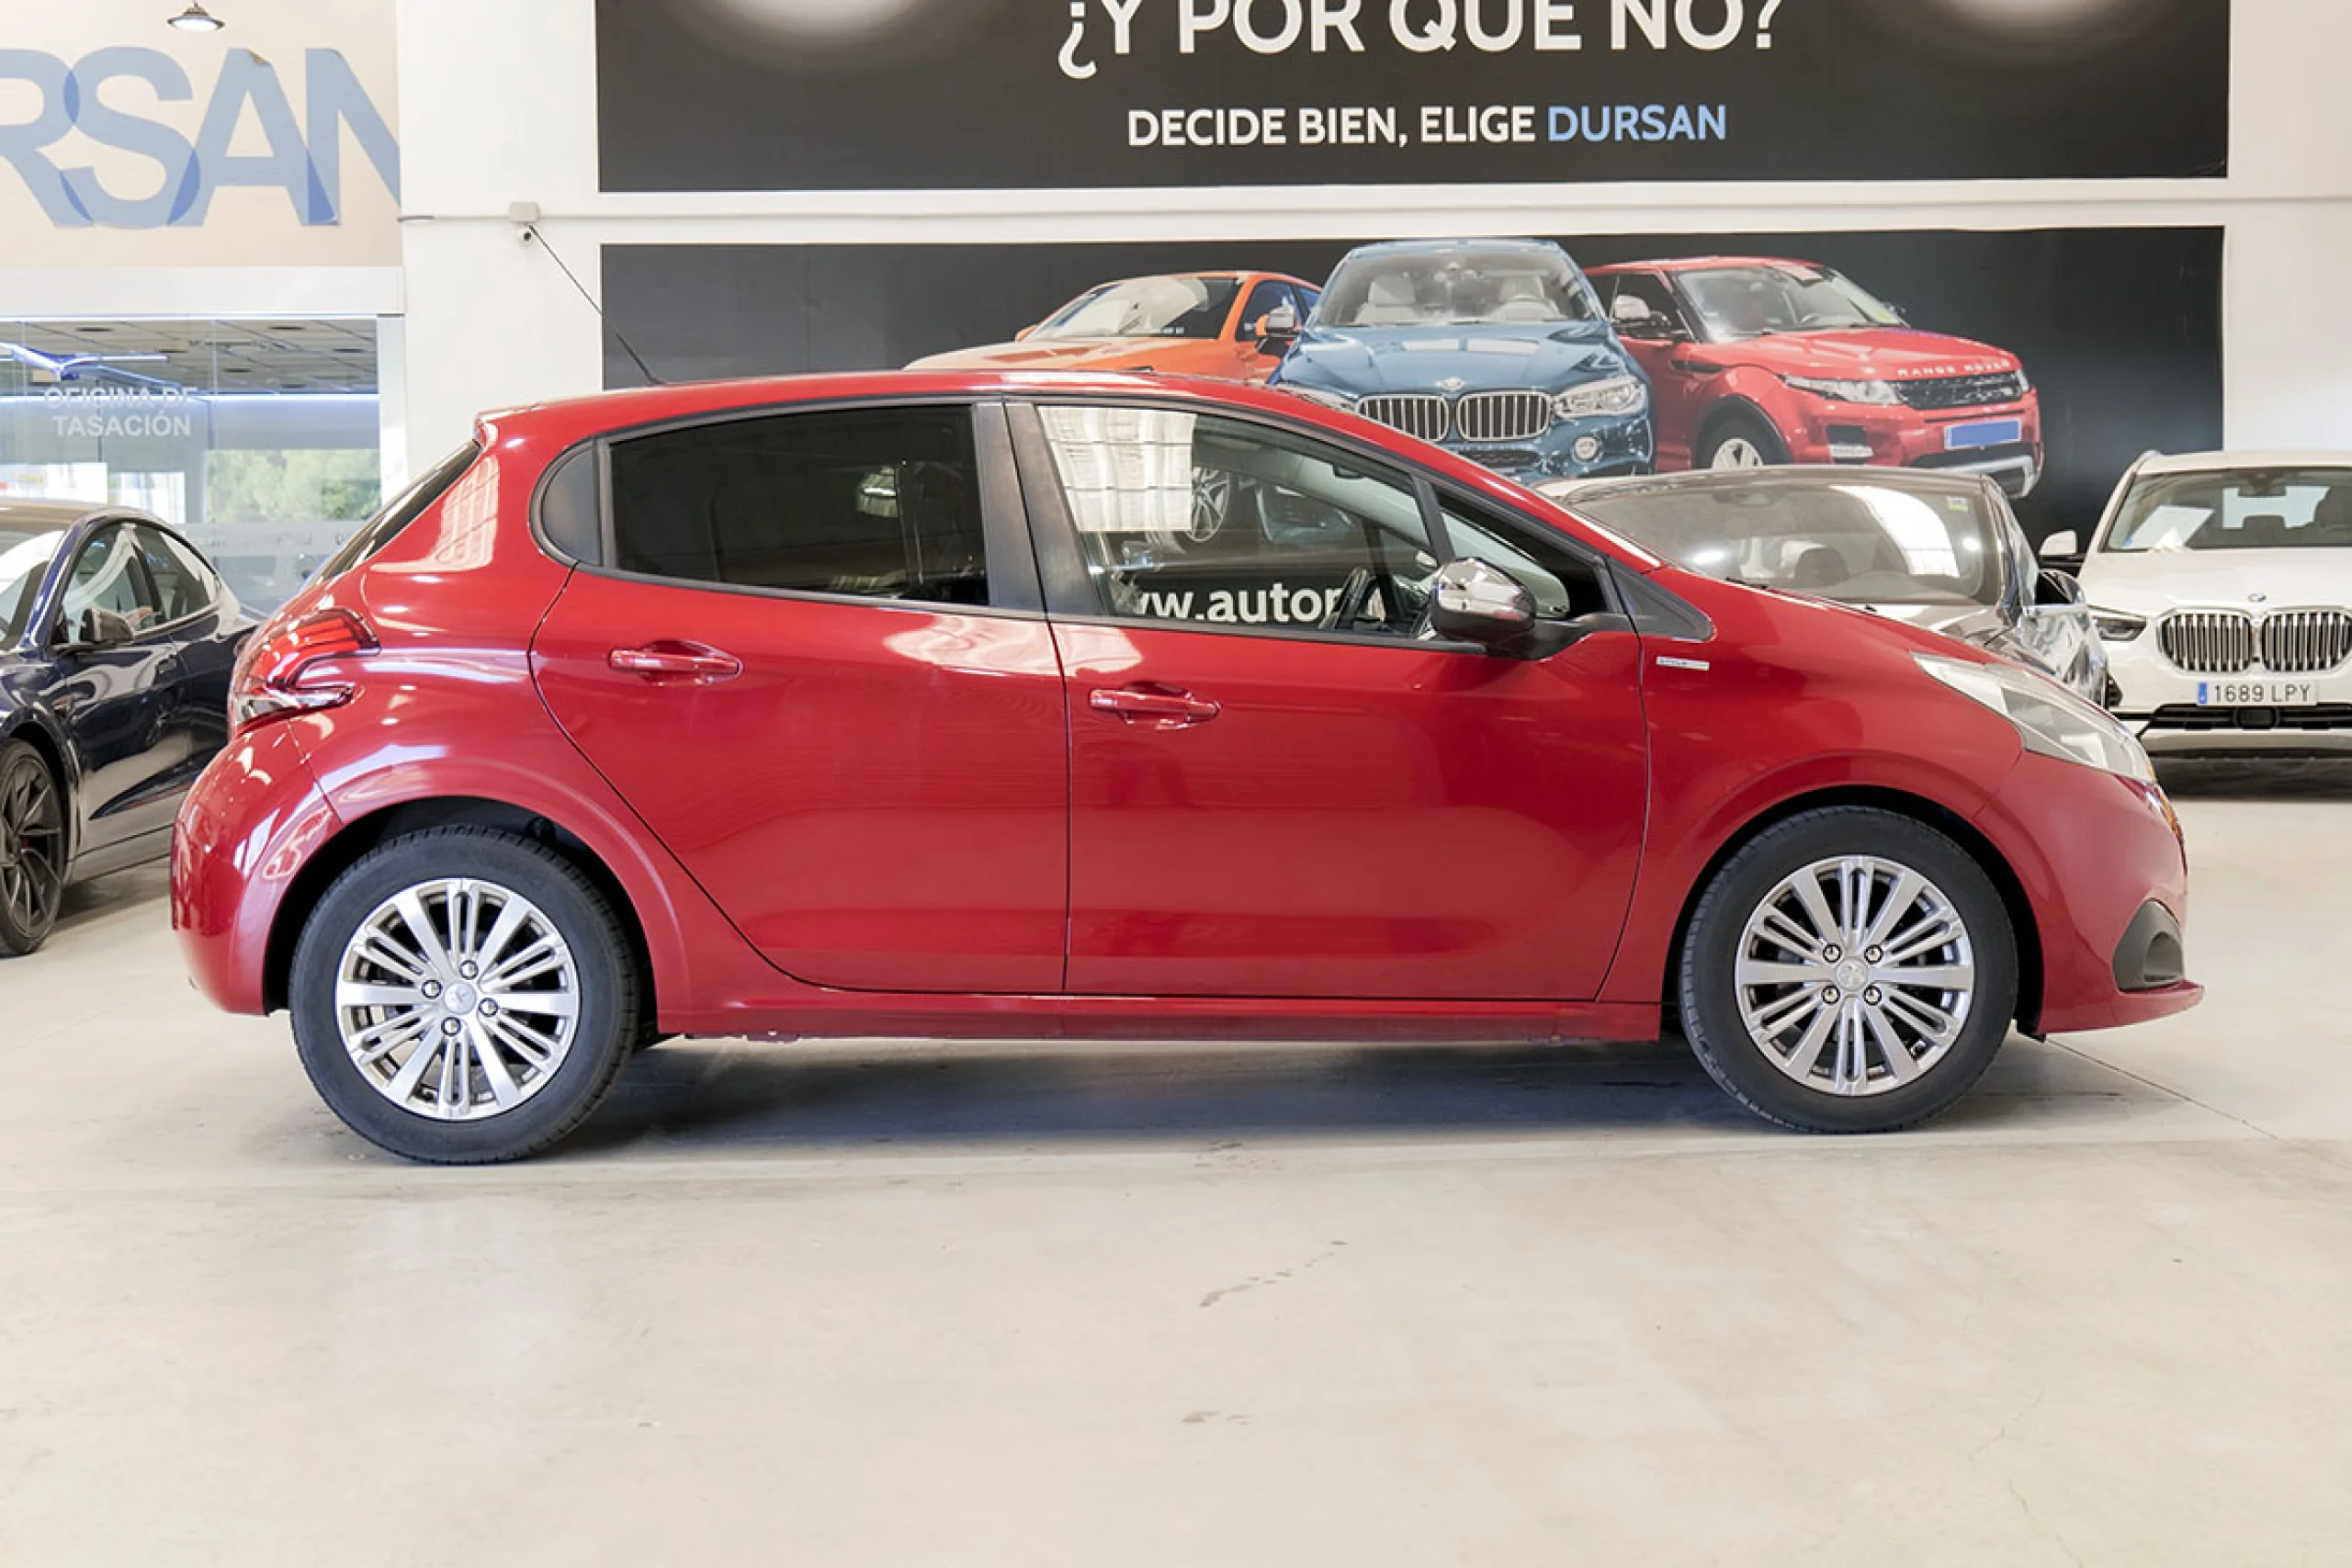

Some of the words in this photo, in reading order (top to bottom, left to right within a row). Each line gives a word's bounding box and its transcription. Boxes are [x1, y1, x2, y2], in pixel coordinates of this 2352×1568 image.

[1057, 0, 1142, 79] ¿Y
[1179, 0, 1365, 54] POR
[1388, 0, 1582, 52] QUE
[1611, 0, 1781, 51] NO?
[0, 46, 401, 229] RSAN
[1127, 108, 1286, 147] DECIDE
[1298, 107, 1408, 149] BIEN,
[1420, 105, 1536, 143] ELIGE
[1547, 104, 1726, 142] DURSAN
[44, 386, 156, 410] OFICINA
[161, 386, 198, 409] DE
[51, 409, 192, 437] TASACIÓN
[2214, 683, 2265, 703] 1689
[2270, 683, 2312, 703] LPY
